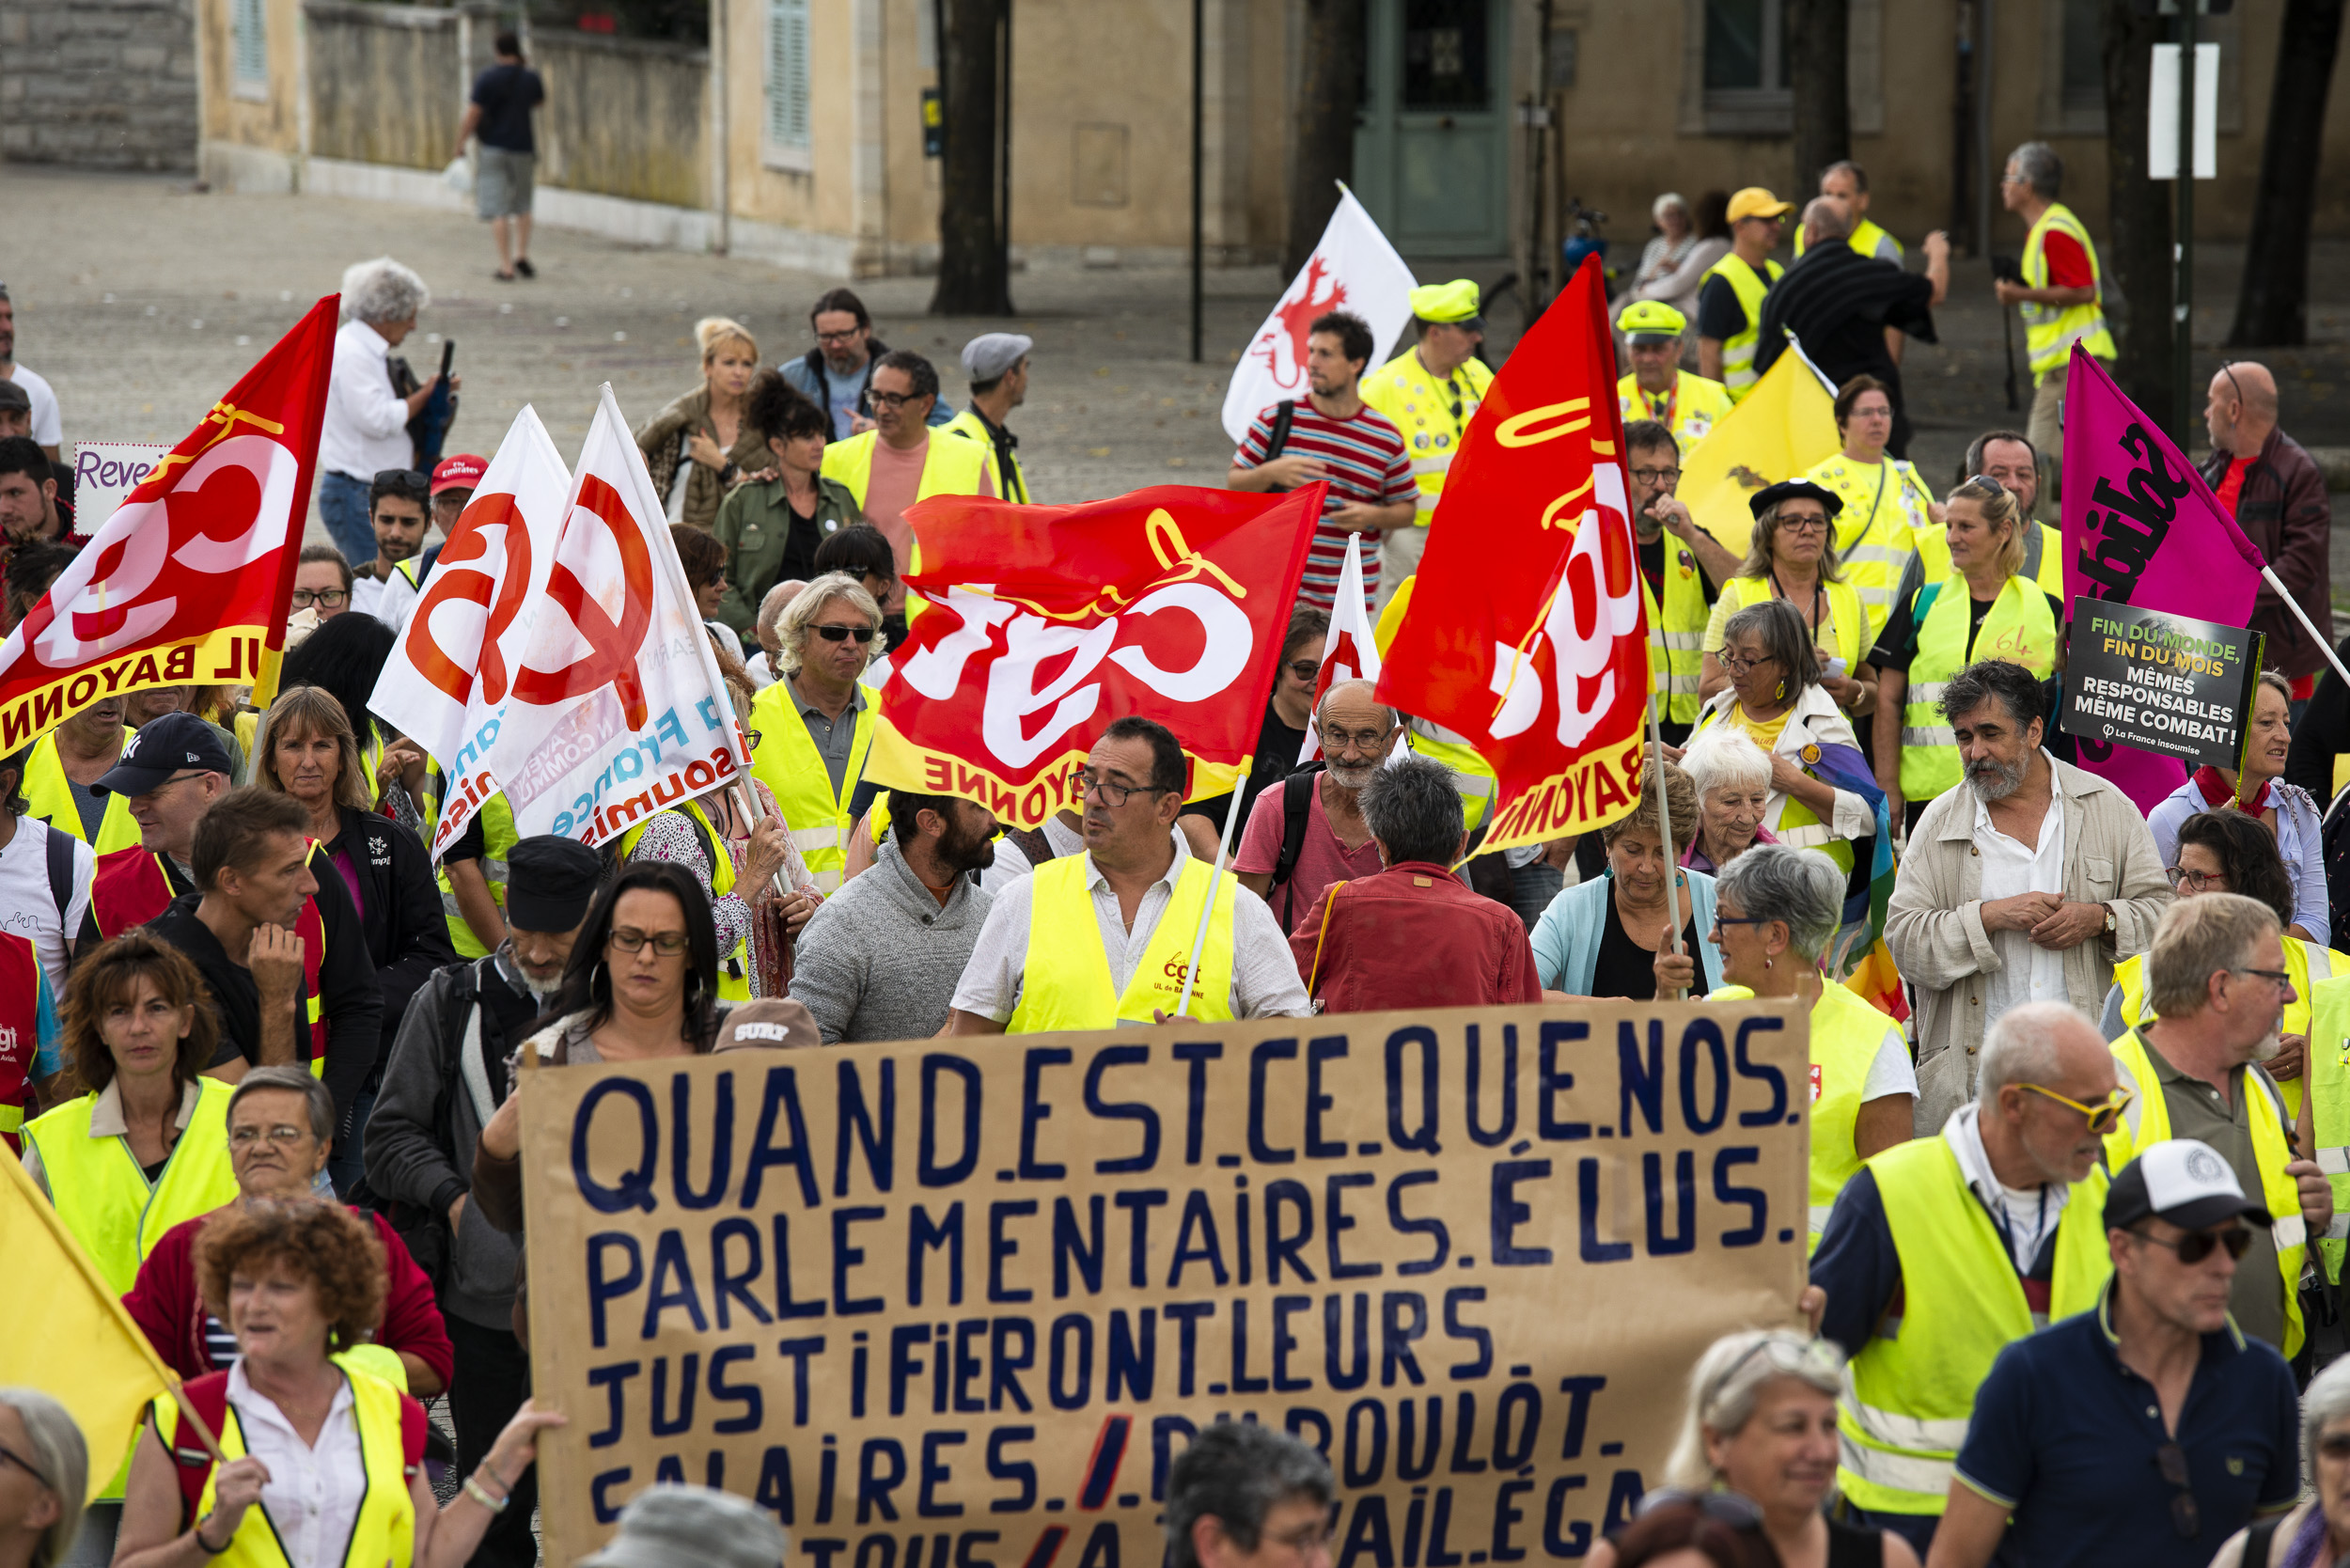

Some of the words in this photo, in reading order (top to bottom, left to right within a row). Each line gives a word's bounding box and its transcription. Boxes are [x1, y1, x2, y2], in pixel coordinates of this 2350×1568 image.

[75, 451, 164, 490] Reve
[442, 466, 478, 478] Emirates
[1996, 624, 2033, 656] 64
[2091, 617, 2124, 638] FIN
[2128, 624, 2159, 644] DU
[2162, 631, 2241, 665] MONDE,
[2103, 637, 2137, 658] FIN
[2140, 645, 2170, 665] DU
[2173, 651, 2225, 677] MOIS
[2126, 666, 2196, 696] MÊMES
[2075, 695, 2138, 724] MÊME
[2083, 676, 2233, 723] RESPONSABLES
[2115, 729, 2126, 739] La
[2127, 730, 2156, 745] France
[2156, 738, 2201, 756] insoumise
[1174, 986, 1204, 999] BANNE
[734, 1021, 790, 1043] SURF
